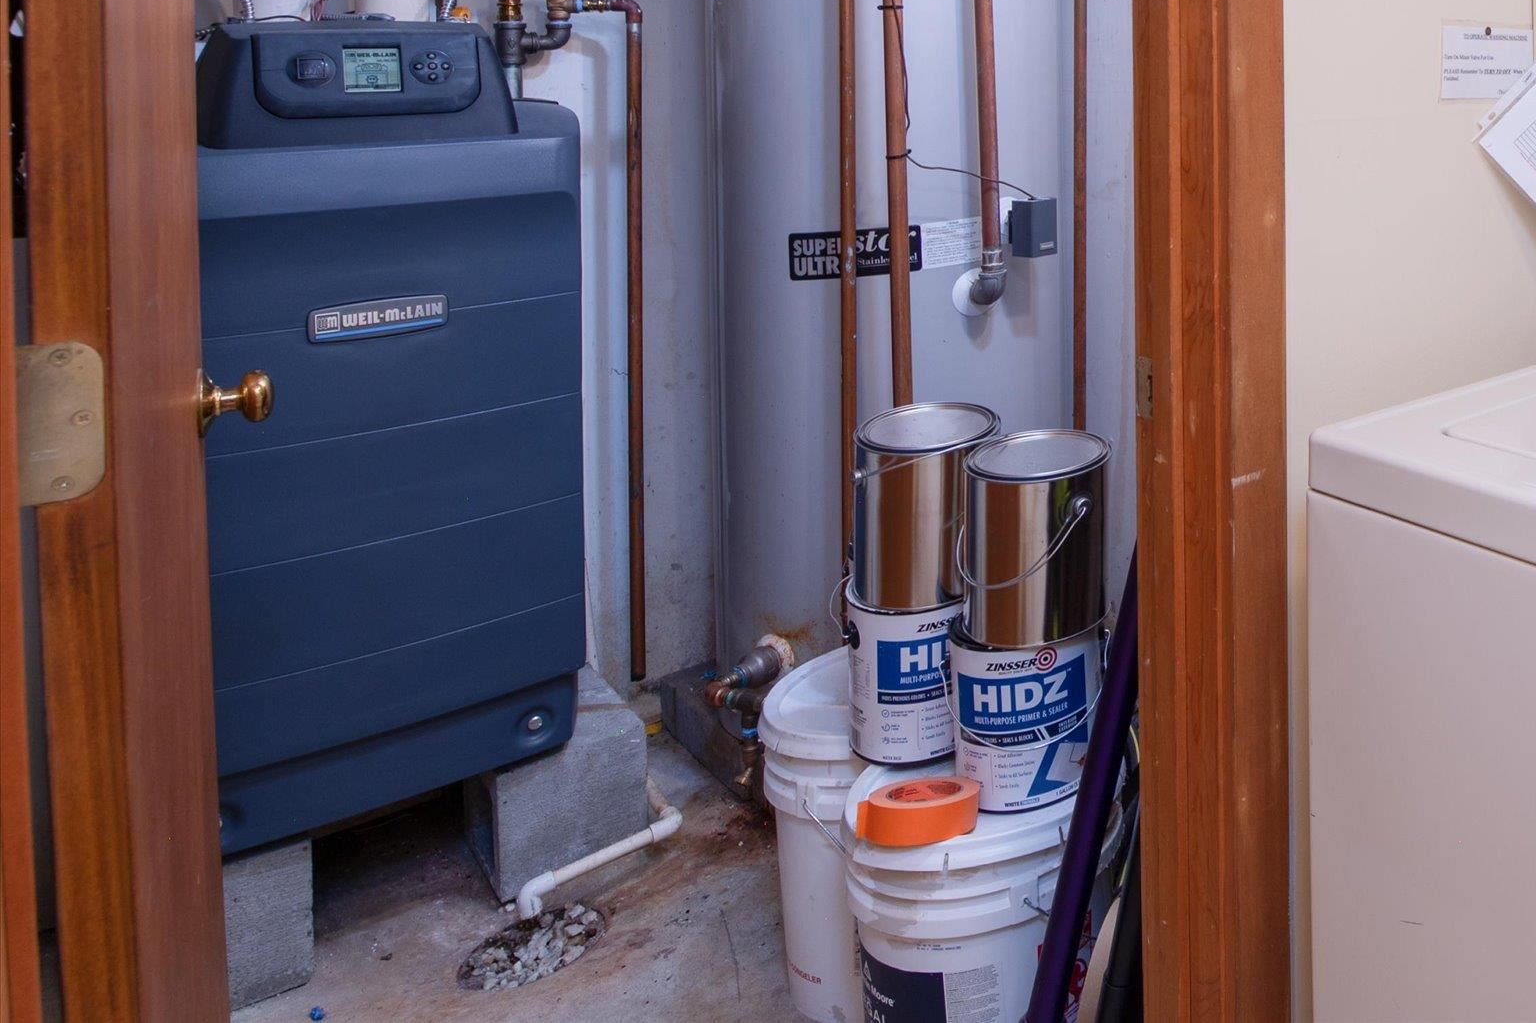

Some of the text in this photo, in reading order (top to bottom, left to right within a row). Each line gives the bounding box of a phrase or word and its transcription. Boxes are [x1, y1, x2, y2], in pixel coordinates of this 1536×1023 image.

[793, 237, 842, 257] SUPE
[793, 255, 840, 276] ULTR
[857, 257, 890, 266] Stainle
[917, 617, 952, 633] ZINSS
[986, 657, 1038, 672] ZINSSER
[900, 672, 945, 684] MULTI-PURPO
[973, 670, 1068, 714] HIDZ
[974, 701, 1068, 725] MULTI-PURPOSE PRIMER & SEALER
[1018, 734, 1034, 742] BLOCKS
